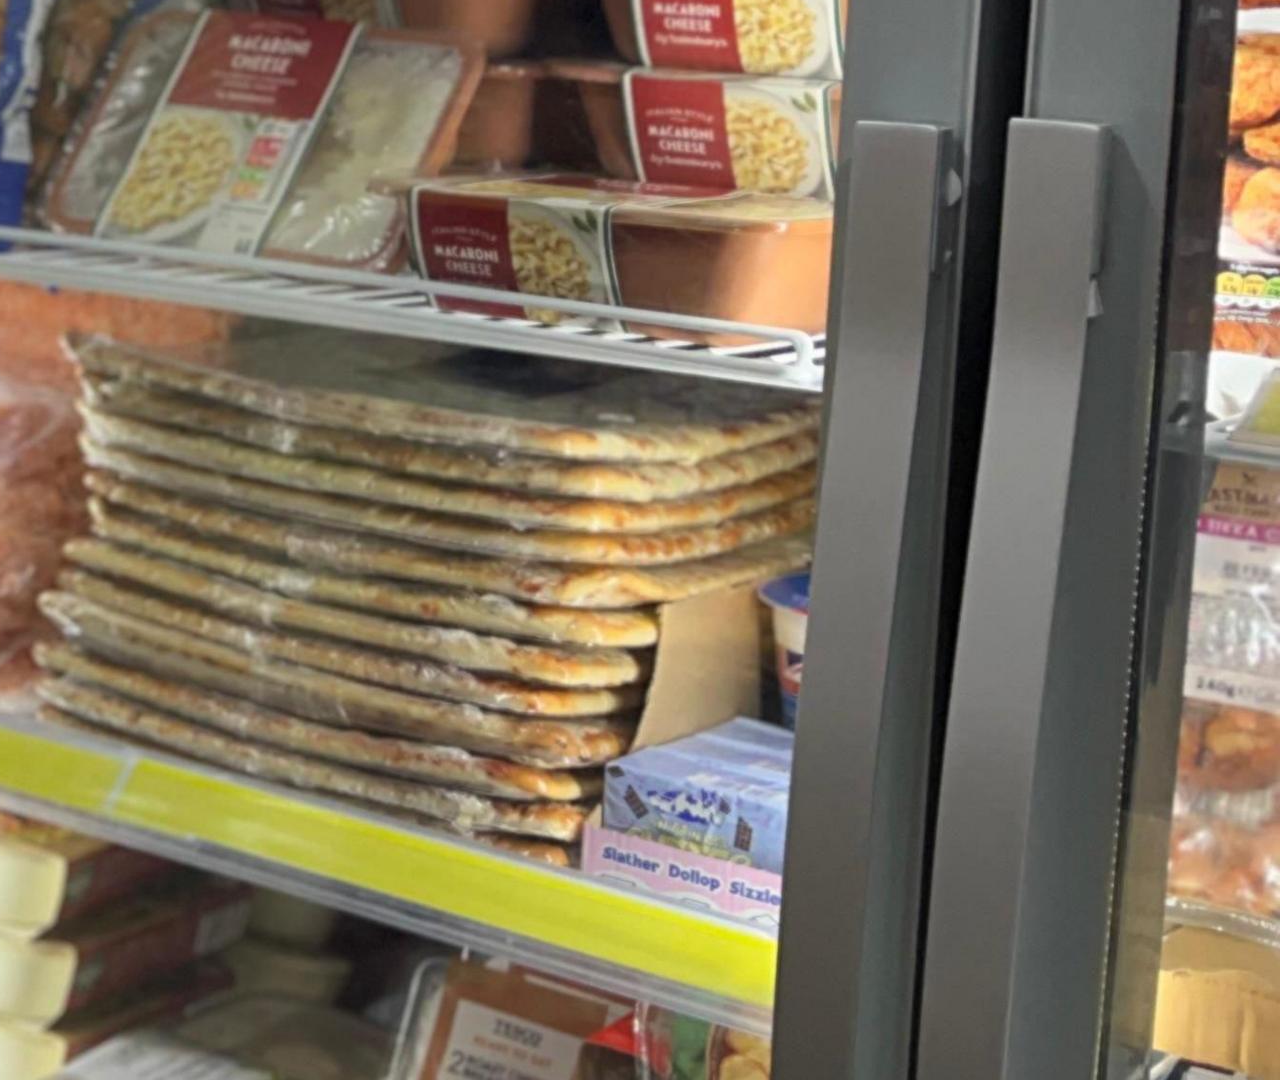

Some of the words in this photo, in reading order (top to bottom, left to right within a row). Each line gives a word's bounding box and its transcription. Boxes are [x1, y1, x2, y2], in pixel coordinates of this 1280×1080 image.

[653, 1, 721, 18] MACARONI
[663, 17, 712, 33] CHEESE
[227, 34, 314, 58] MACARONI
[230, 52, 292, 75] CHEESE
[647, 124, 715, 141] MACARONI
[658, 139, 707, 156] CHEESE
[433, 244, 500, 264] MACARONI
[444, 259, 493, 277] CHEESE
[602, 846, 660, 873] Slather
[668, 864, 721, 891] Dollop
